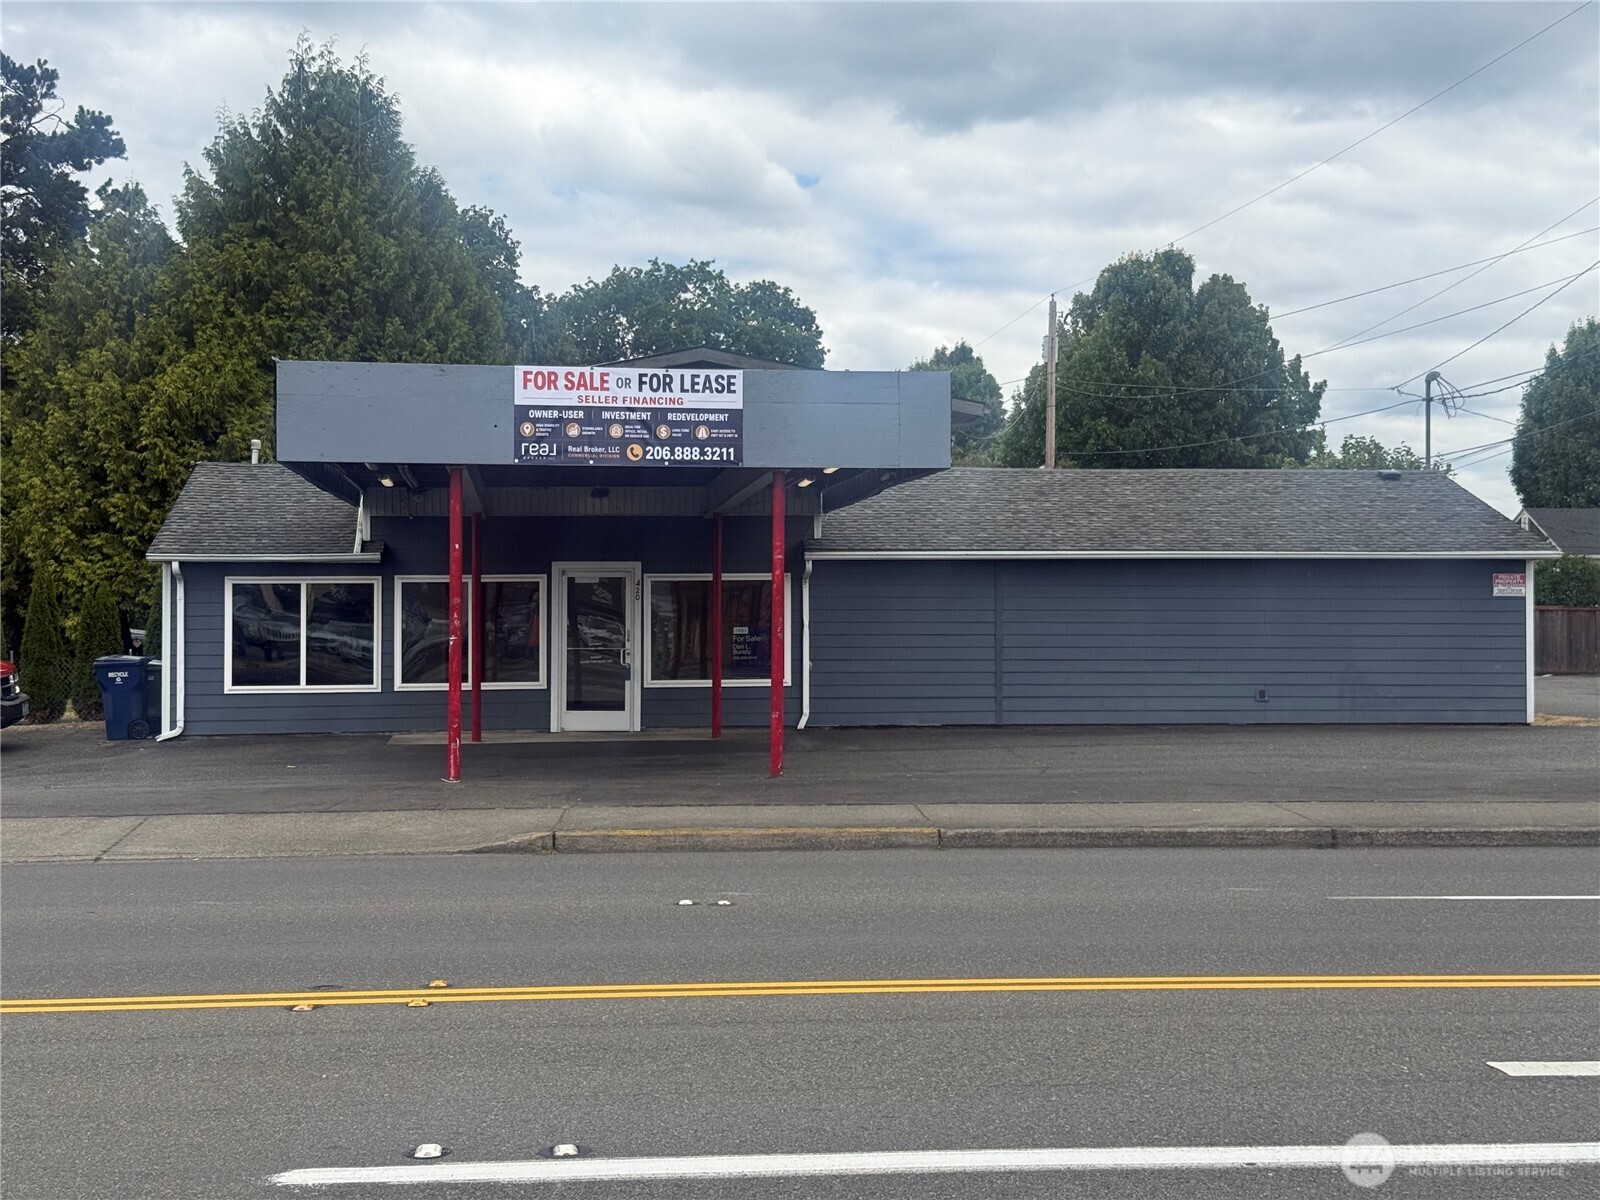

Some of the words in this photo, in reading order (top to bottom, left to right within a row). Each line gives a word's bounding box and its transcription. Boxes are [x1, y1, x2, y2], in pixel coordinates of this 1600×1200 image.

[523, 370, 559, 391] FOR
[564, 371, 610, 392] SALE
[616, 377, 632, 389] OR
[638, 373, 674, 393] FOR
[680, 374, 737, 394] LEASE
[577, 395, 618, 405] SELLER
[622, 396, 684, 406] FINANCING
[528, 409, 585, 419] OWNER-USER
[601, 411, 652, 421] INVESTMENT
[667, 412, 729, 422] REDEVELOPMENT
[521, 442, 557, 456] real
[567, 445, 582, 453] Real
[583, 446, 607, 454] Broker,
[645, 446, 734, 461] 206.888.3211
